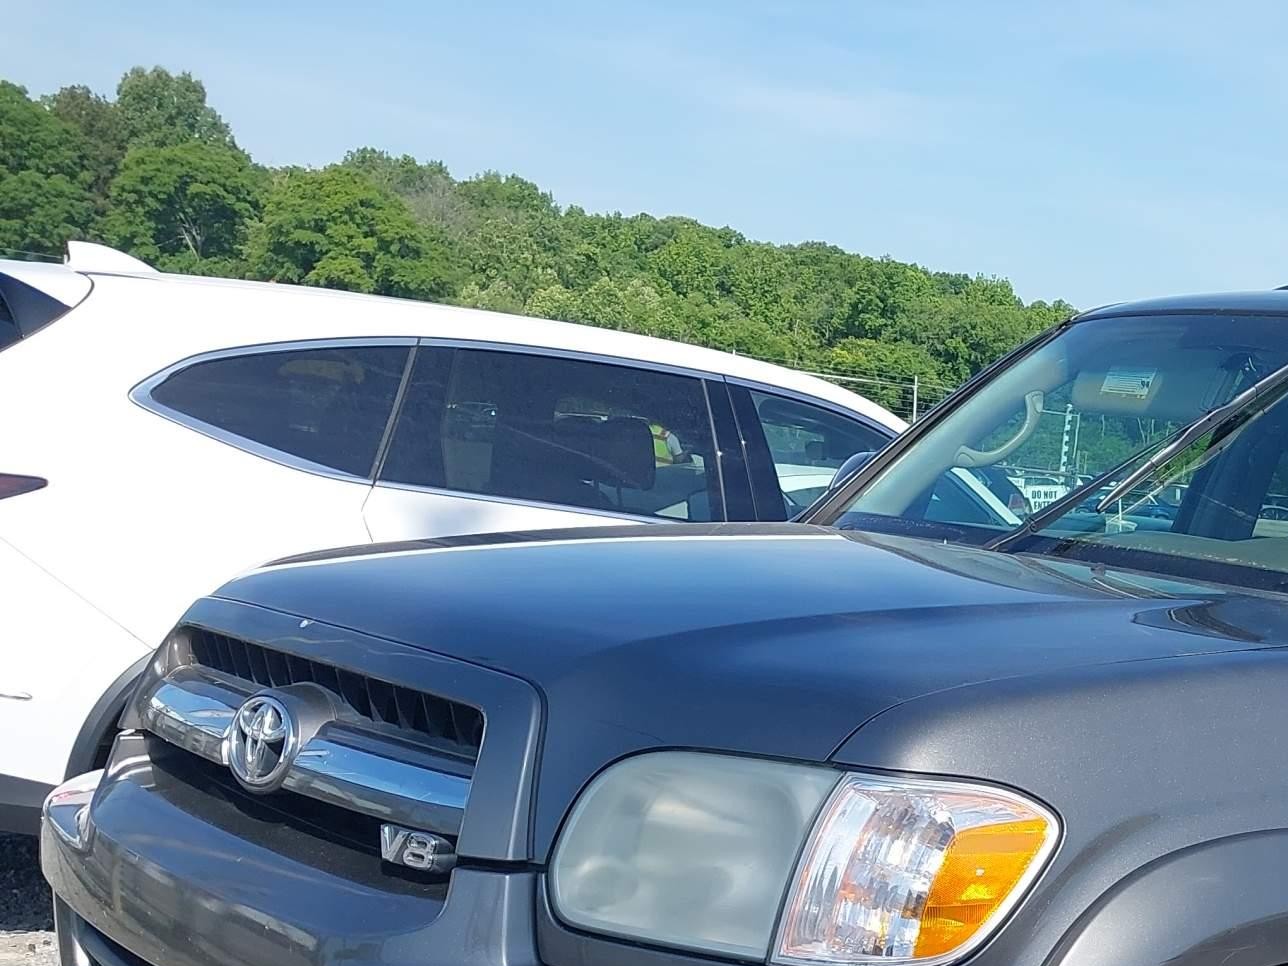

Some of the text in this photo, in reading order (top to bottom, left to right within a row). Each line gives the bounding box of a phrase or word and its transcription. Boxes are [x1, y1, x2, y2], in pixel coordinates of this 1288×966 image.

[1031, 490, 1057, 499] DO NOT
[381, 824, 435, 871] V8
